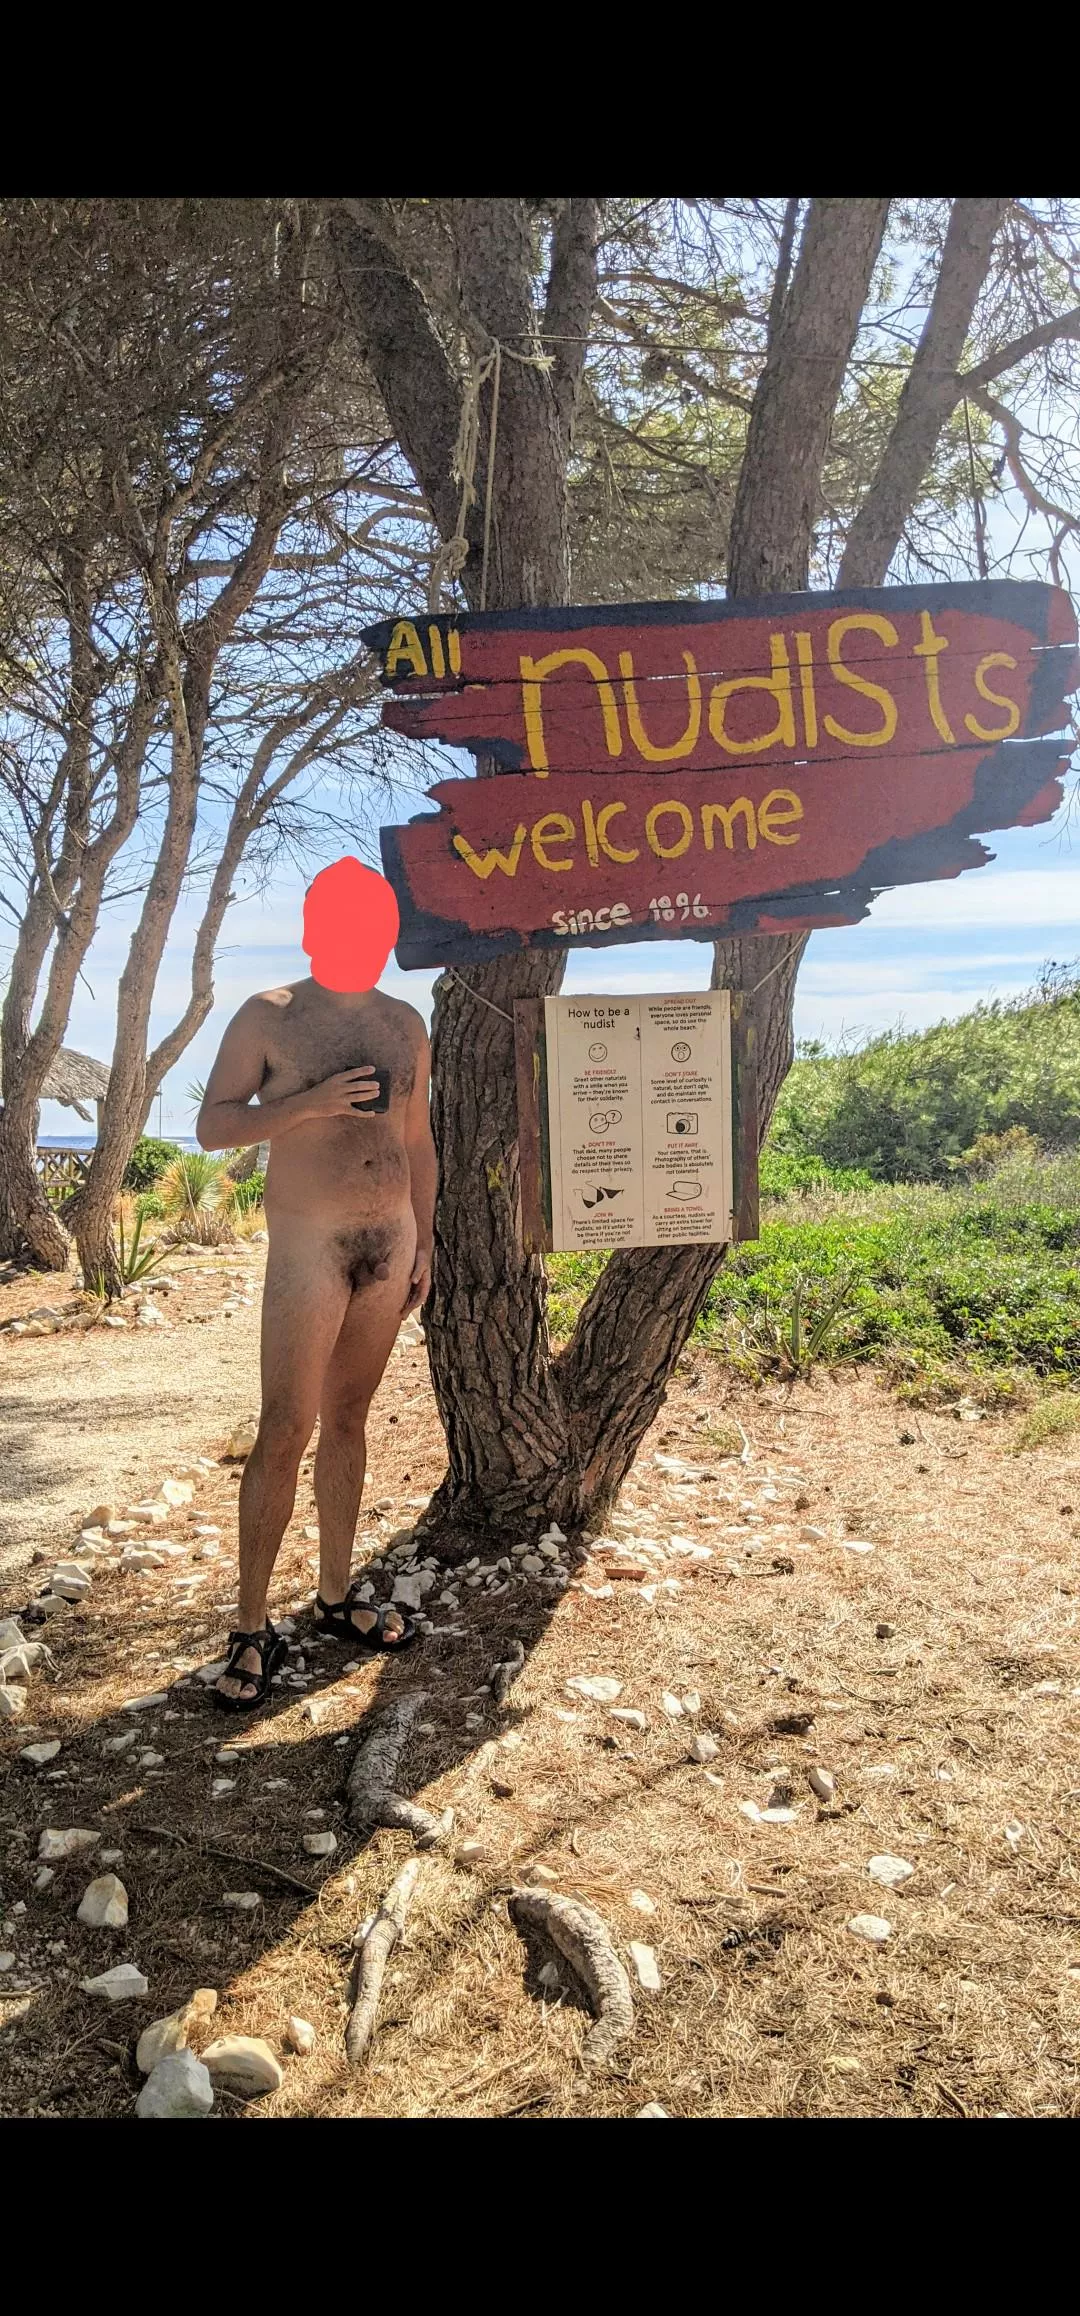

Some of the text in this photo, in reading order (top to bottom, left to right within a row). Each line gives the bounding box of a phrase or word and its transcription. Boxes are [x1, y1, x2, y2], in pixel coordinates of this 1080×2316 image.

[386, 621, 461, 678] All
[453, 789, 804, 879] welcome
[552, 902, 632, 935] since
[568, 1007, 630, 1018] How to be a
[583, 1018, 615, 1029] nudist
